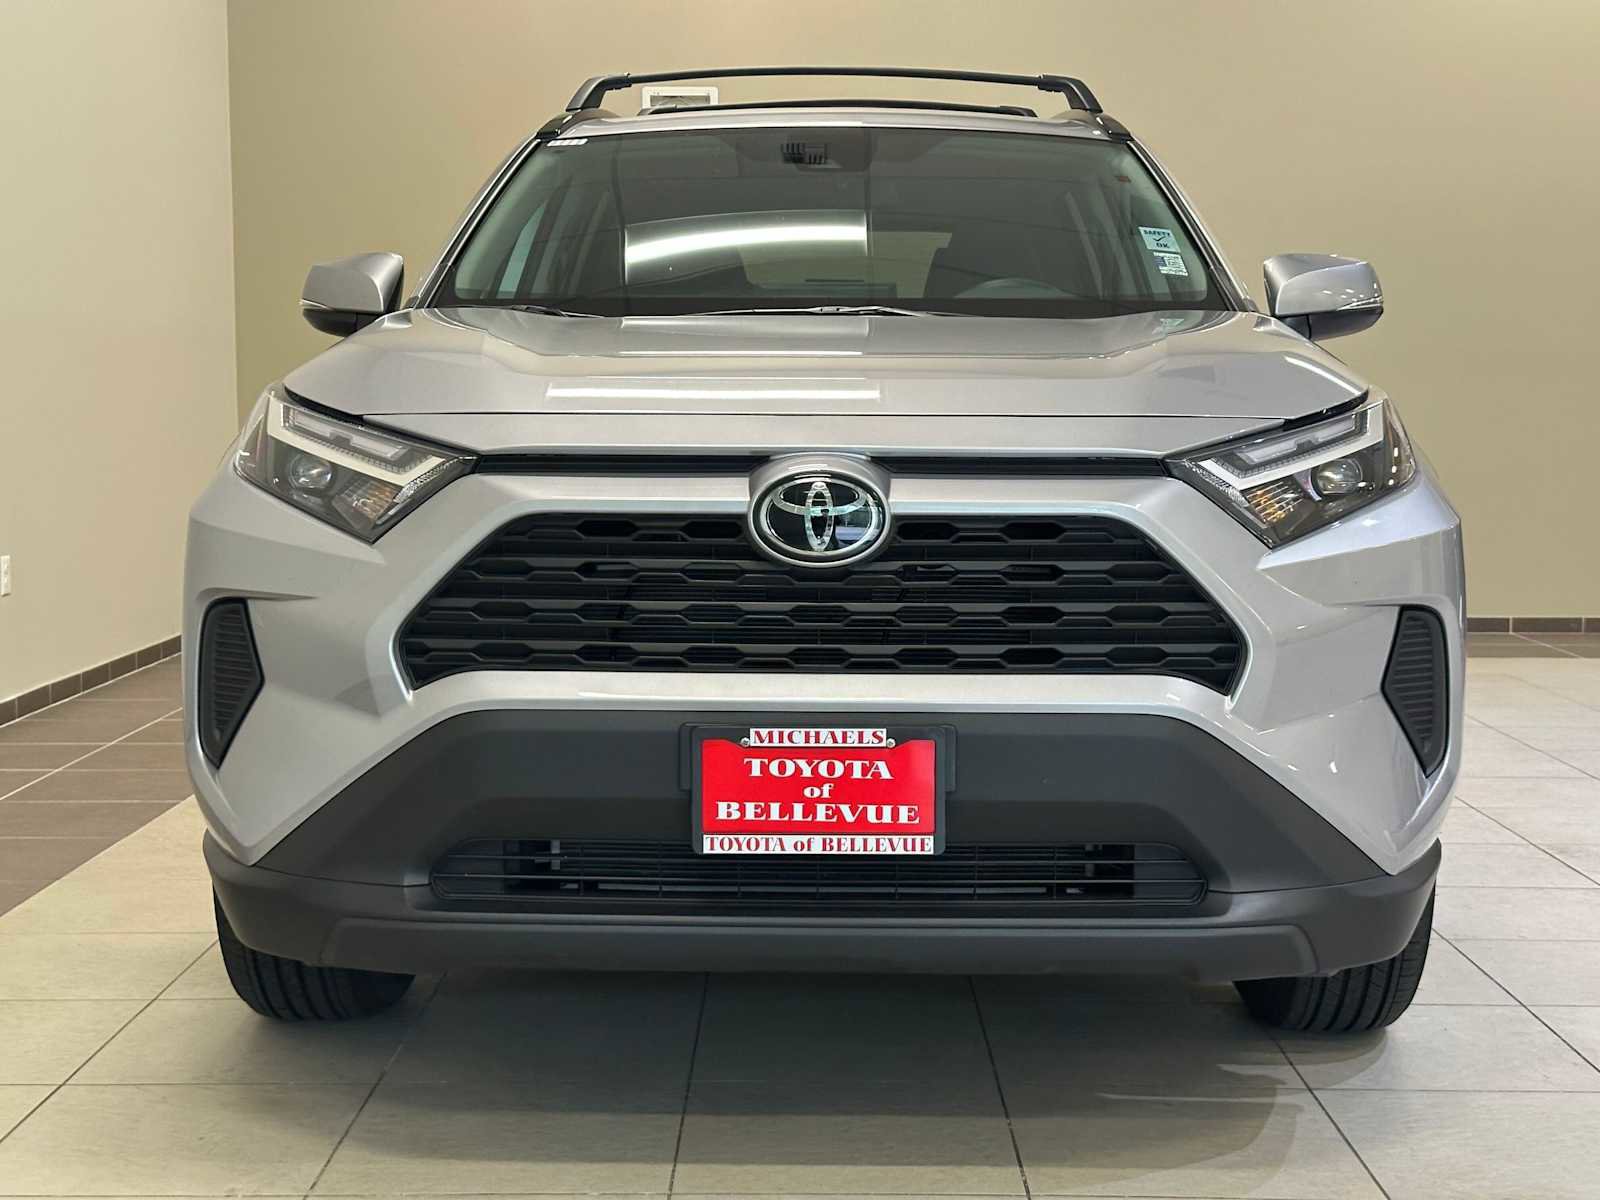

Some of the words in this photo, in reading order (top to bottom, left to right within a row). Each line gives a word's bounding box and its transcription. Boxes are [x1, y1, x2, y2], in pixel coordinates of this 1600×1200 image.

[753, 730, 884, 744] MICHAELS
[744, 758, 893, 779] TOYOTA
[803, 783, 834, 799] of
[715, 801, 921, 824] BELLEVUE
[705, 836, 787, 852] TOYOTA
[793, 837, 814, 852] of
[822, 837, 932, 853] BELLEVUE
